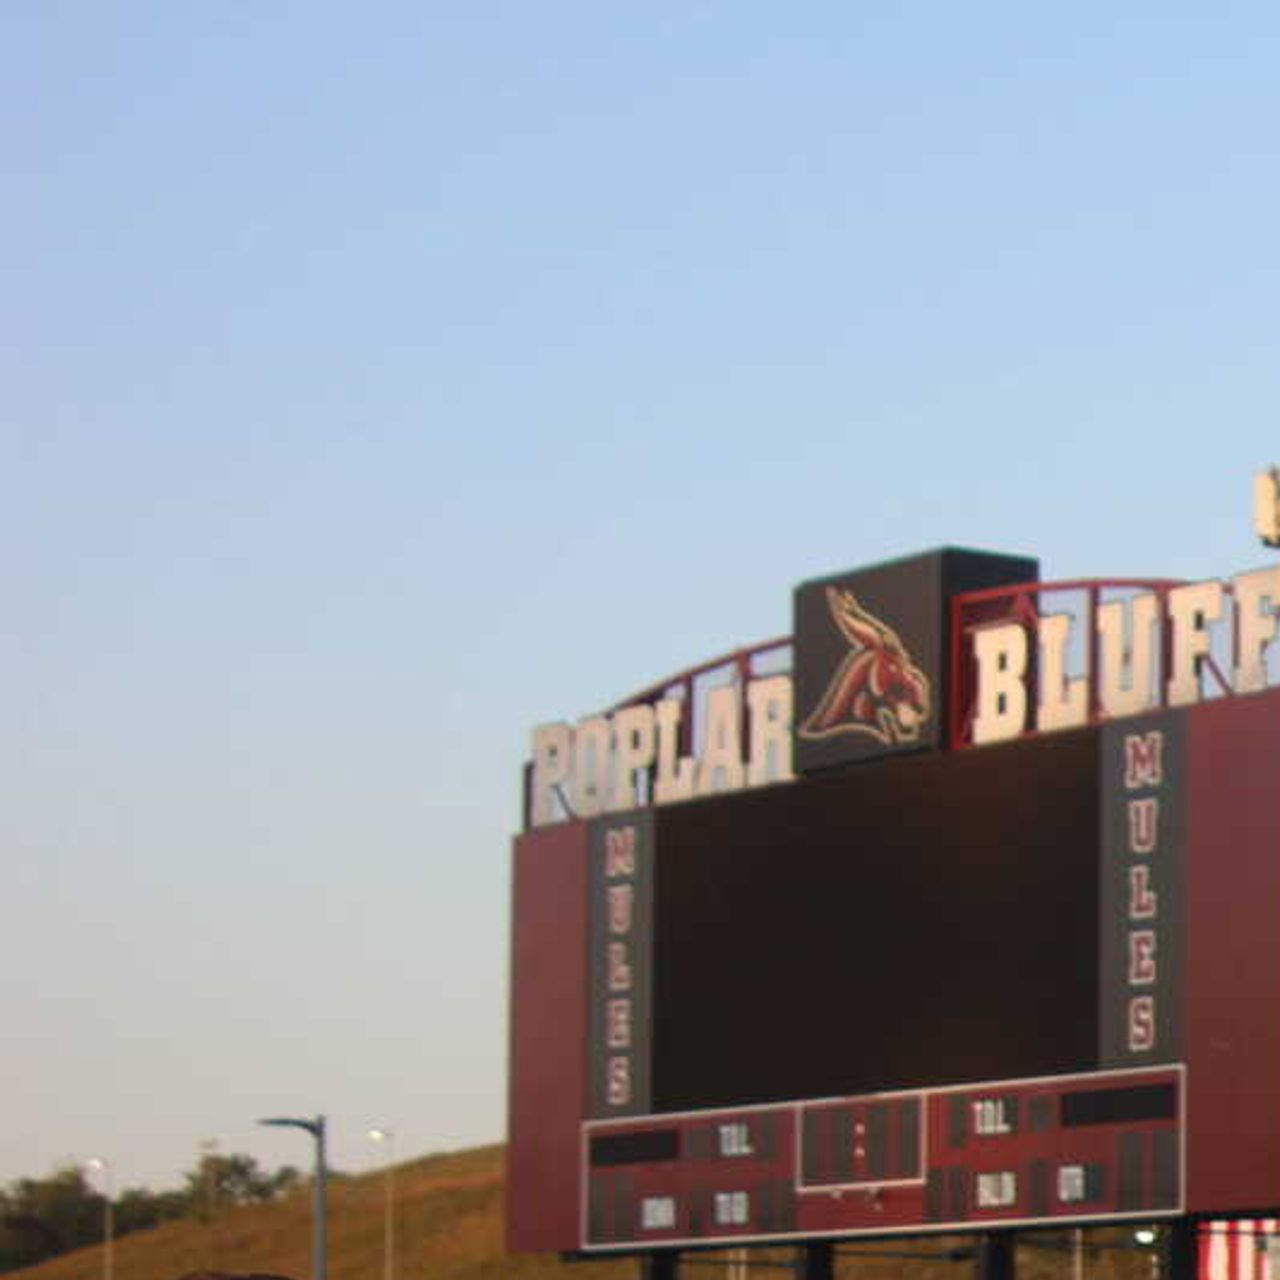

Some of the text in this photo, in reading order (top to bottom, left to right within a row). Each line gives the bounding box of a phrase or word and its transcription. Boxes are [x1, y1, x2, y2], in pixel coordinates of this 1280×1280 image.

[530, 673, 797, 828] POPLAR
[605, 825, 636, 1106] MULES
[1124, 731, 1163, 1052] MULES
